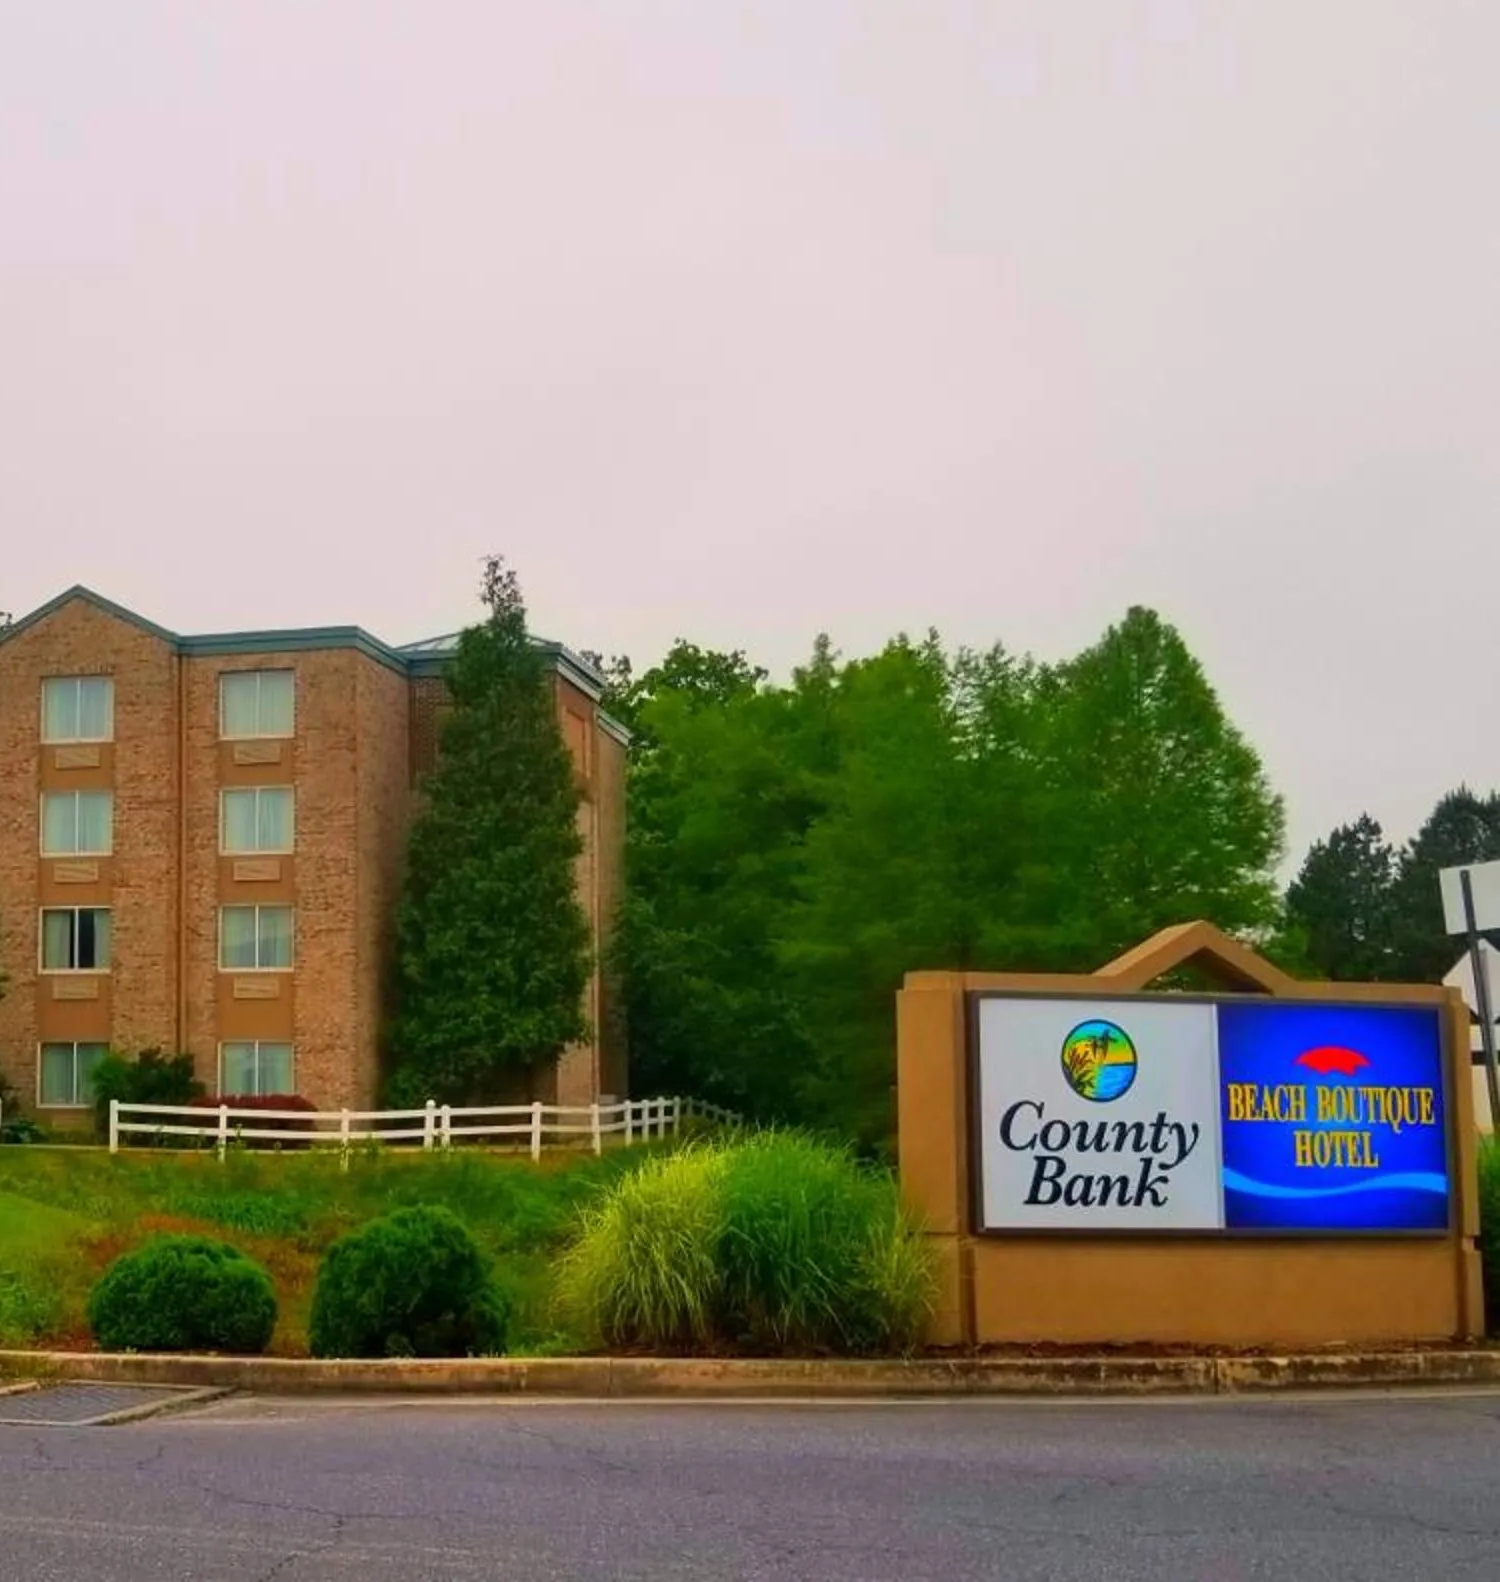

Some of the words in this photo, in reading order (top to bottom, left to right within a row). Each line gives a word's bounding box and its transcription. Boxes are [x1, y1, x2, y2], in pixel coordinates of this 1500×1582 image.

[1000, 1100, 1199, 1168] County
[1228, 1084, 1306, 1121] BEACH
[1316, 1086, 1435, 1134] BOUTIQUE
[1294, 1131, 1379, 1168] HOTEL
[1023, 1155, 1169, 1208] Bank
